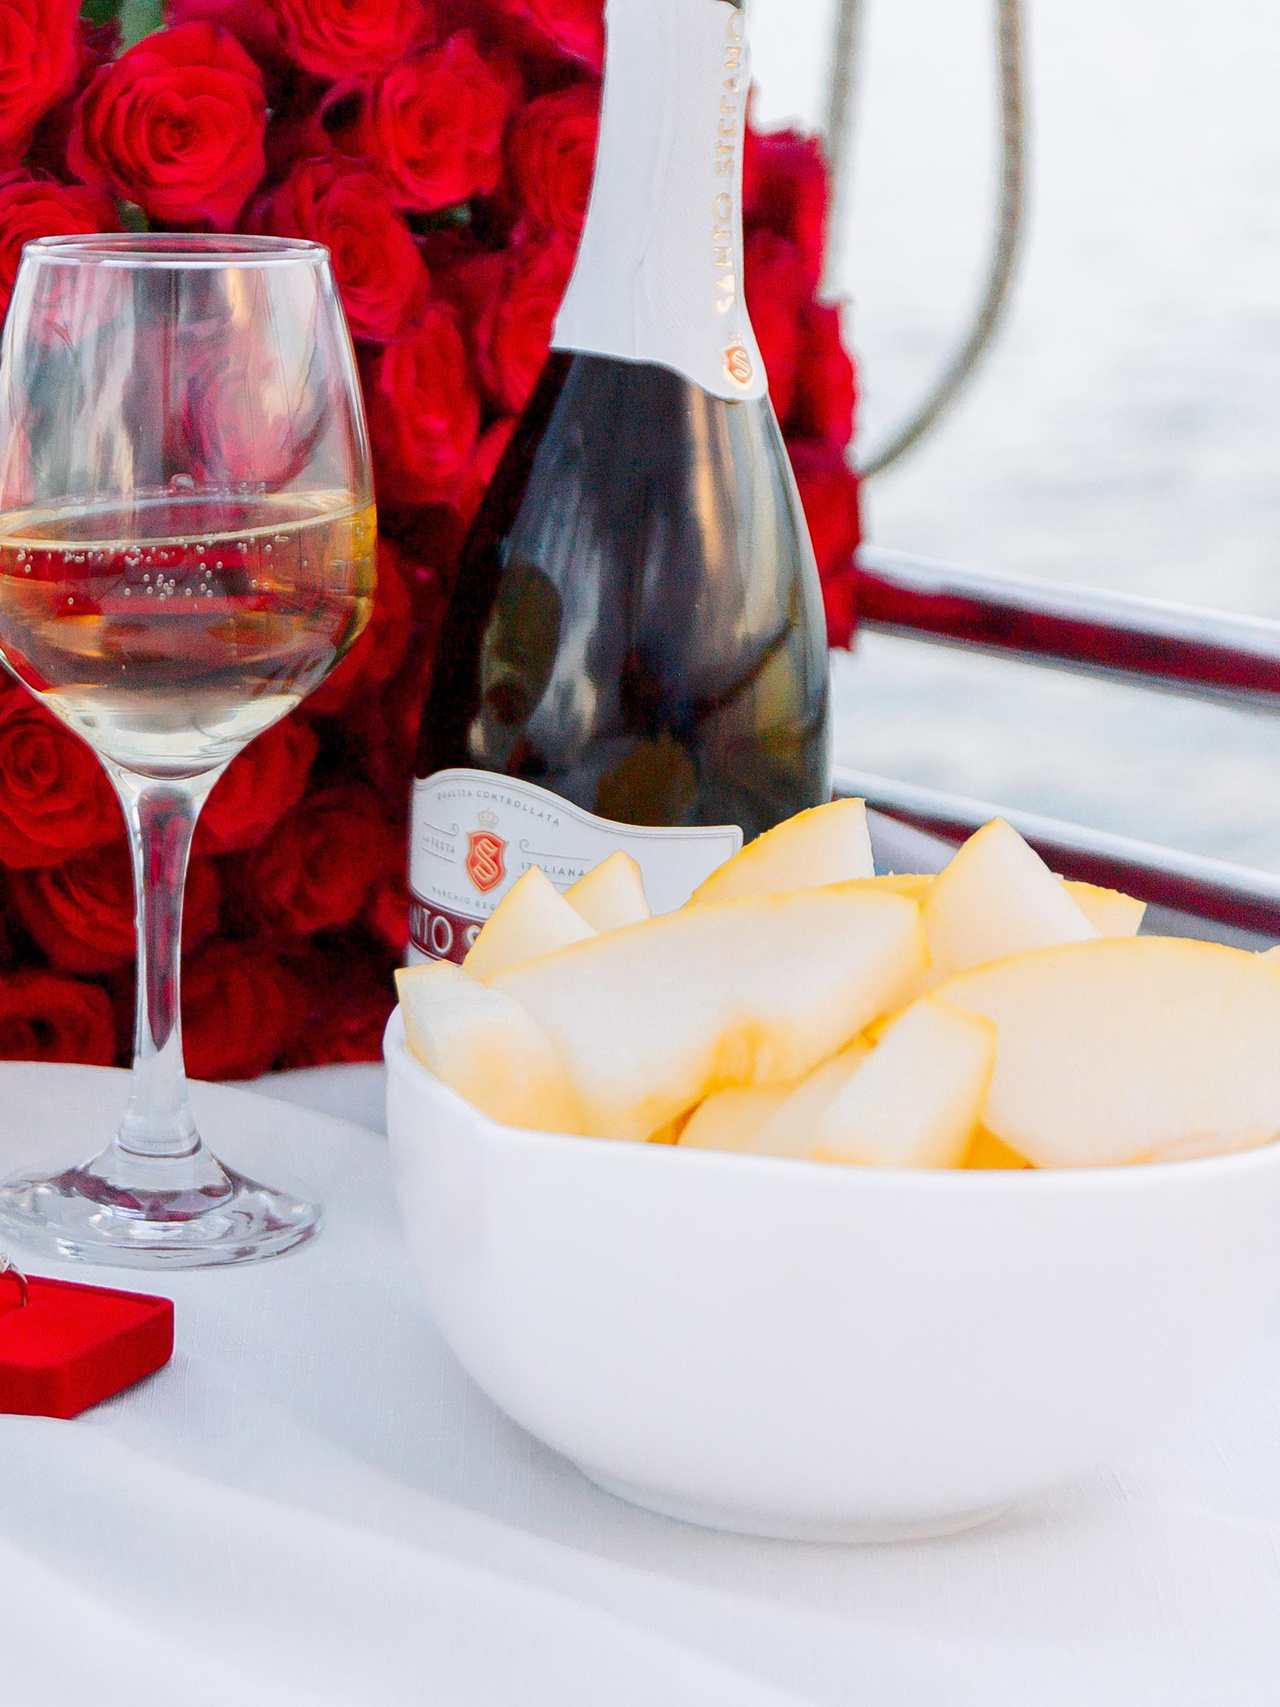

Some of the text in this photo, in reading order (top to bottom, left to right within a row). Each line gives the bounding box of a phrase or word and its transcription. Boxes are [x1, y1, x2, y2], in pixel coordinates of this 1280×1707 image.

[712, 191, 737, 314] SANTO
[476, 789, 560, 826] CONTROLLATA
[430, 836, 456, 853] FESTA
